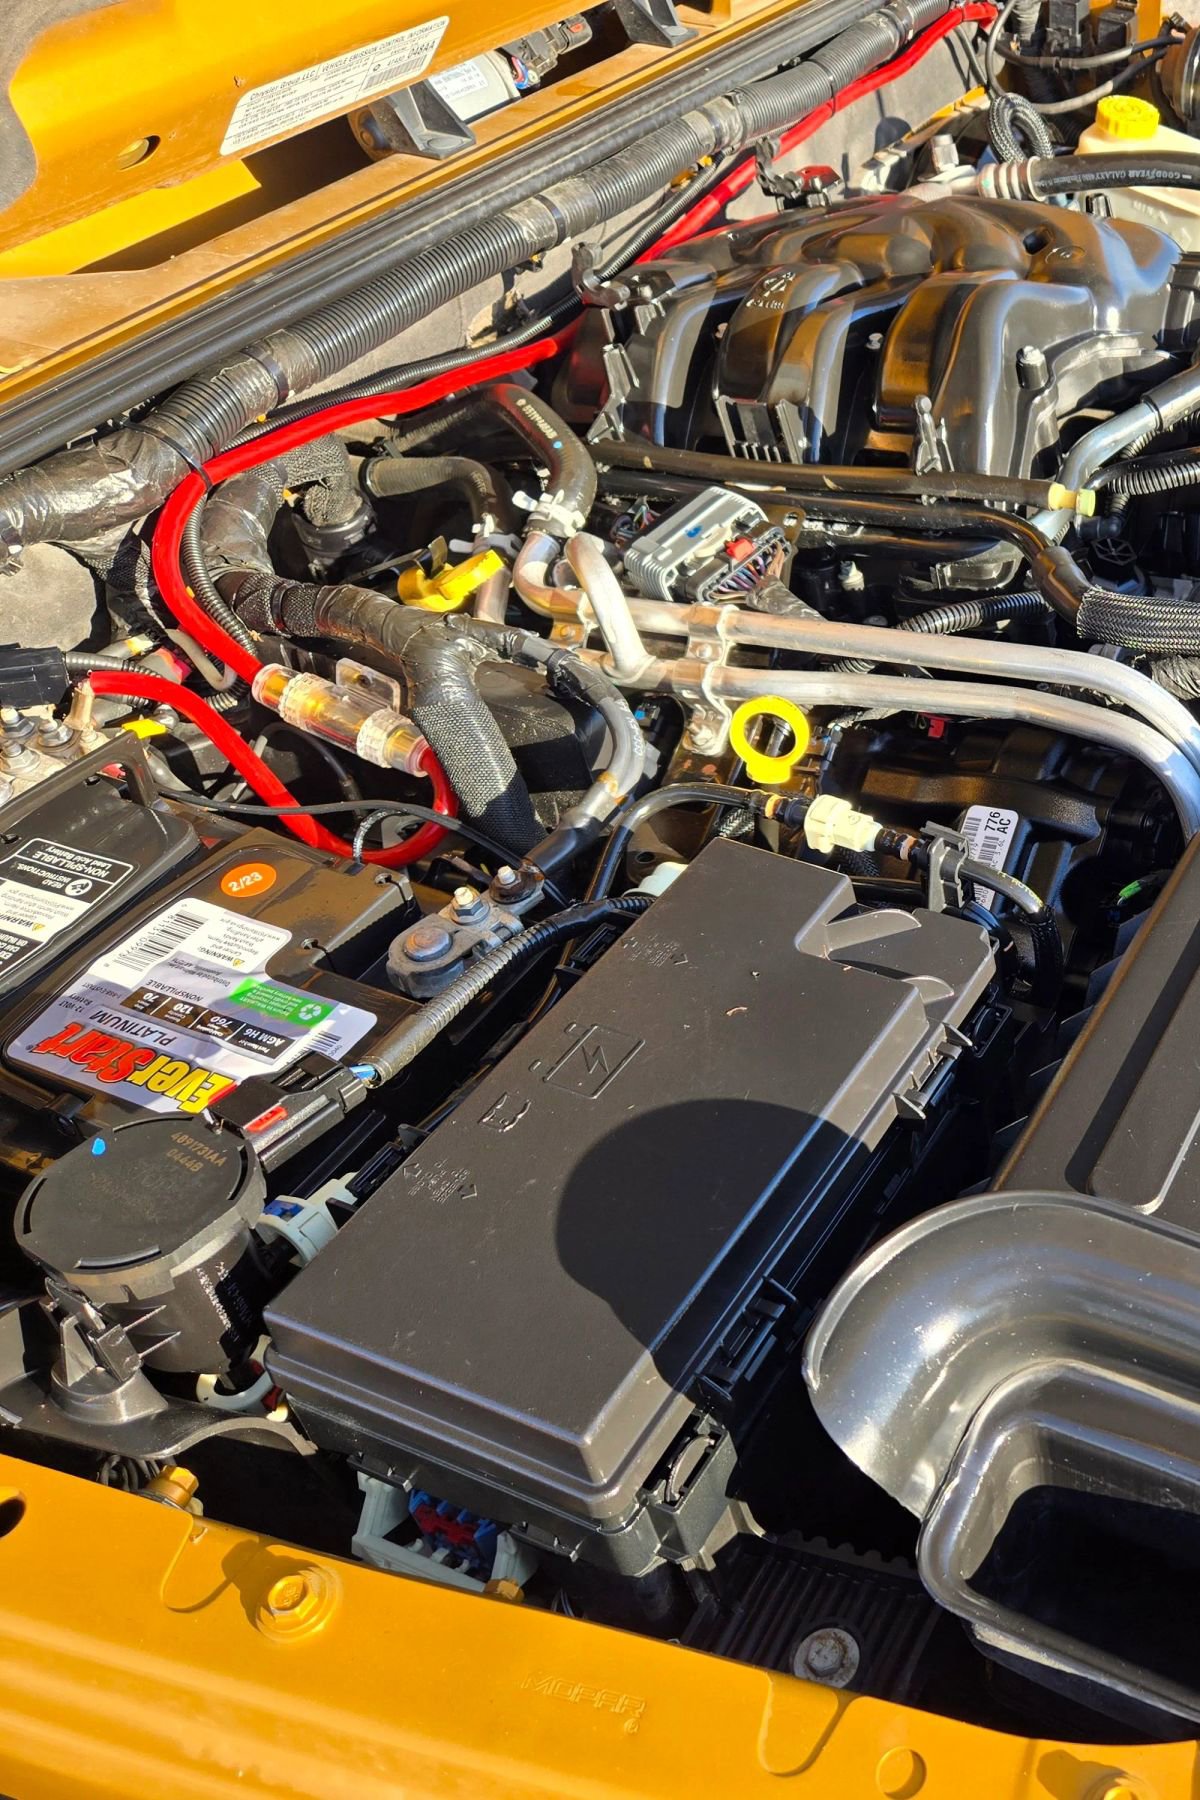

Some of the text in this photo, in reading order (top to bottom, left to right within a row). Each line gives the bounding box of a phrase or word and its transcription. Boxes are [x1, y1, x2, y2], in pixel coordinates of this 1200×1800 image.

[250, 84, 279, 101] Chrysler
[984, 811, 1001, 832] 776
[997, 817, 1012, 835] AC
[32, 850, 110, 878] NON-SPILLABLE
[228, 872, 263, 892] 2/23
[65, 992, 95, 1006] Battery
[141, 991, 160, 1002] 70
[144, 978, 204, 1002] NONSPILLABLE
[57, 998, 87, 1013] 12-VOLT
[170, 1001, 196, 1014] 120
[87, 1008, 178, 1047] PLATINUM
[207, 1014, 233, 1027] 760
[241, 1027, 286, 1047] AGM H6
[35, 1020, 237, 1114] EverStart
[519, 1672, 646, 1721] MOPAR
